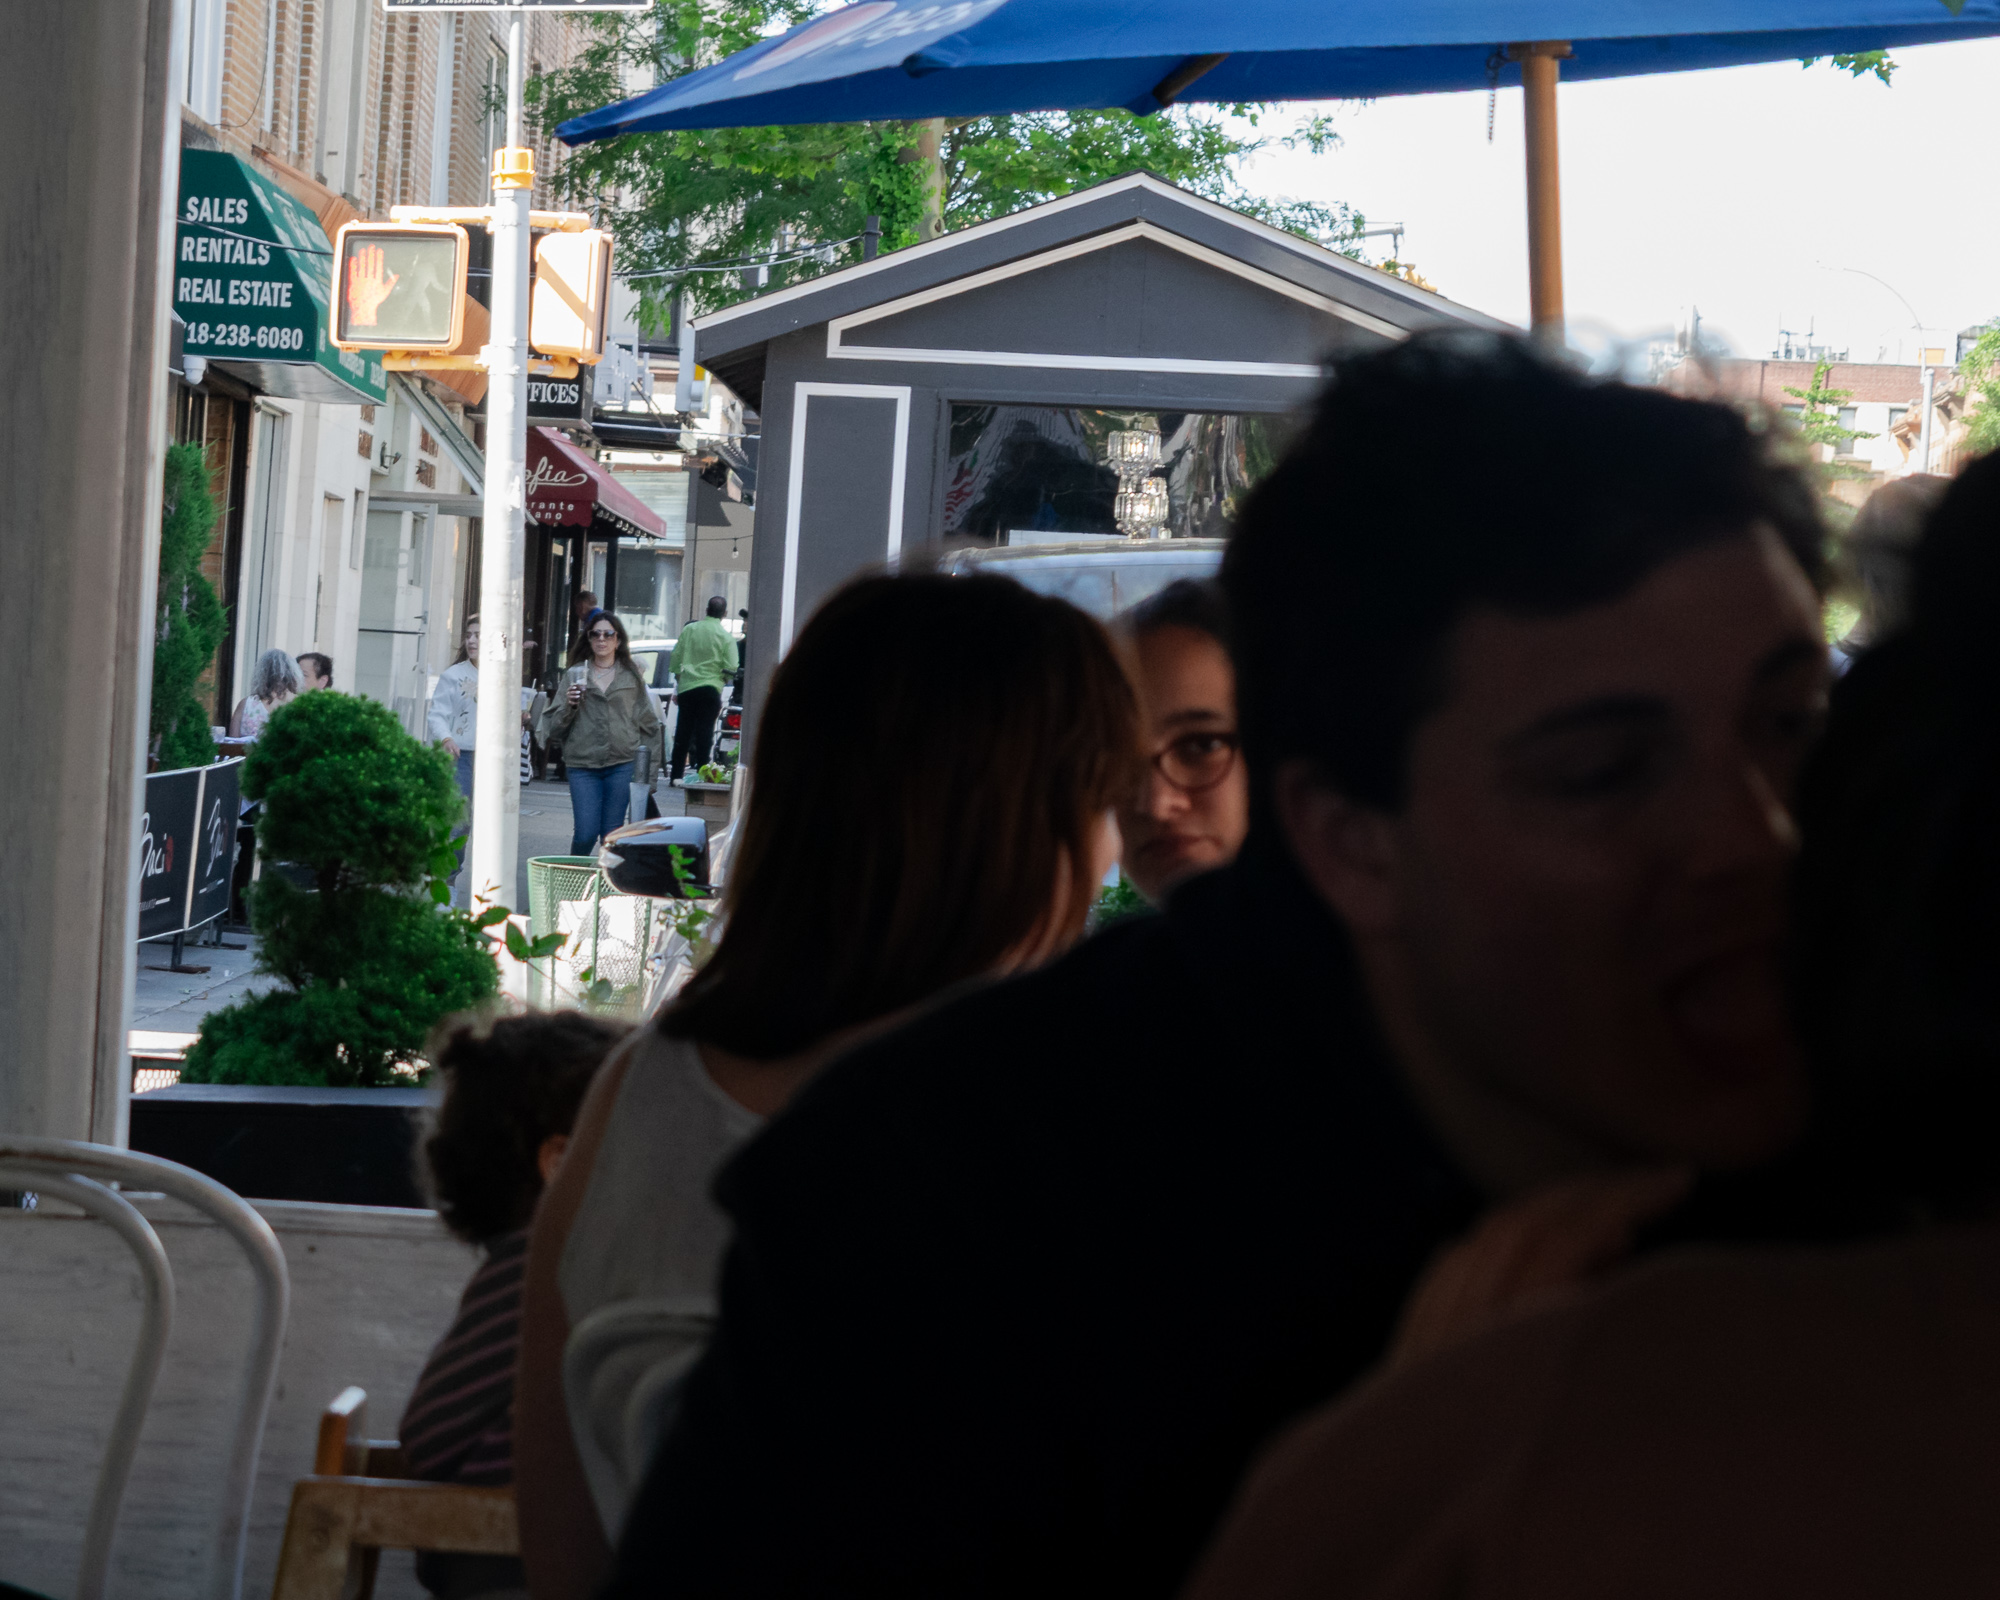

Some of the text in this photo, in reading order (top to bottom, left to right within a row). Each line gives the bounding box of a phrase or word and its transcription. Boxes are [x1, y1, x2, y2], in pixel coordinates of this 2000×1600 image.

[186, 196, 248, 224] SALES
[181, 236, 270, 266] RENTALS
[179, 277, 224, 304] REAL
[228, 279, 293, 308] ESTATE
[184, 321, 303, 350] 18-238-6080
[527, 382, 579, 404] FICES
[525, 501, 574, 511] rante
